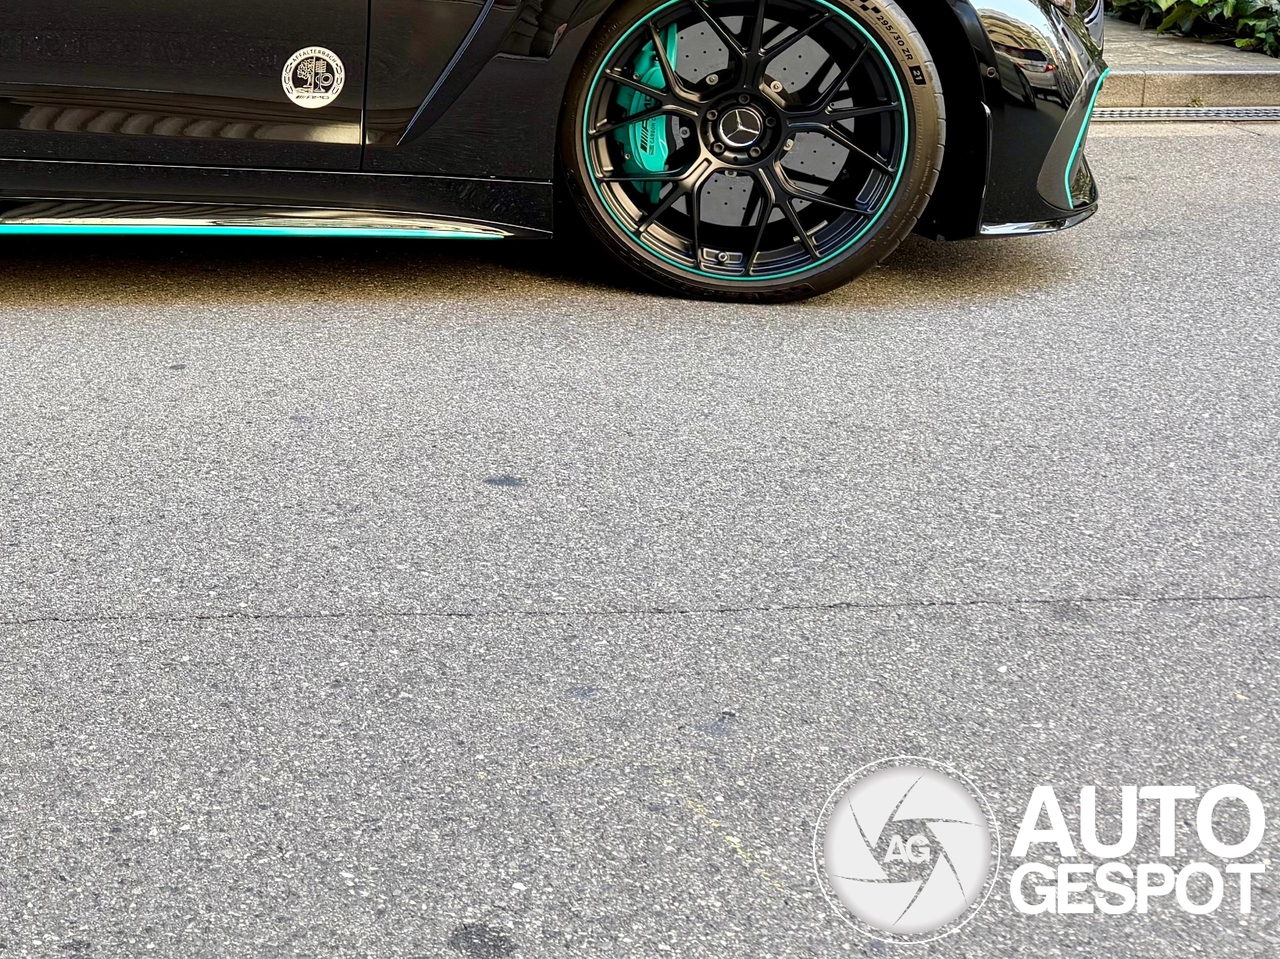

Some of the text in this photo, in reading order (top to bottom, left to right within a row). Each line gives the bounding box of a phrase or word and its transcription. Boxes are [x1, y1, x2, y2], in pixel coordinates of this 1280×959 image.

[292, 49, 337, 63] AFFALTERBACH
[876, 15, 923, 80] 295/30 ZR 21
